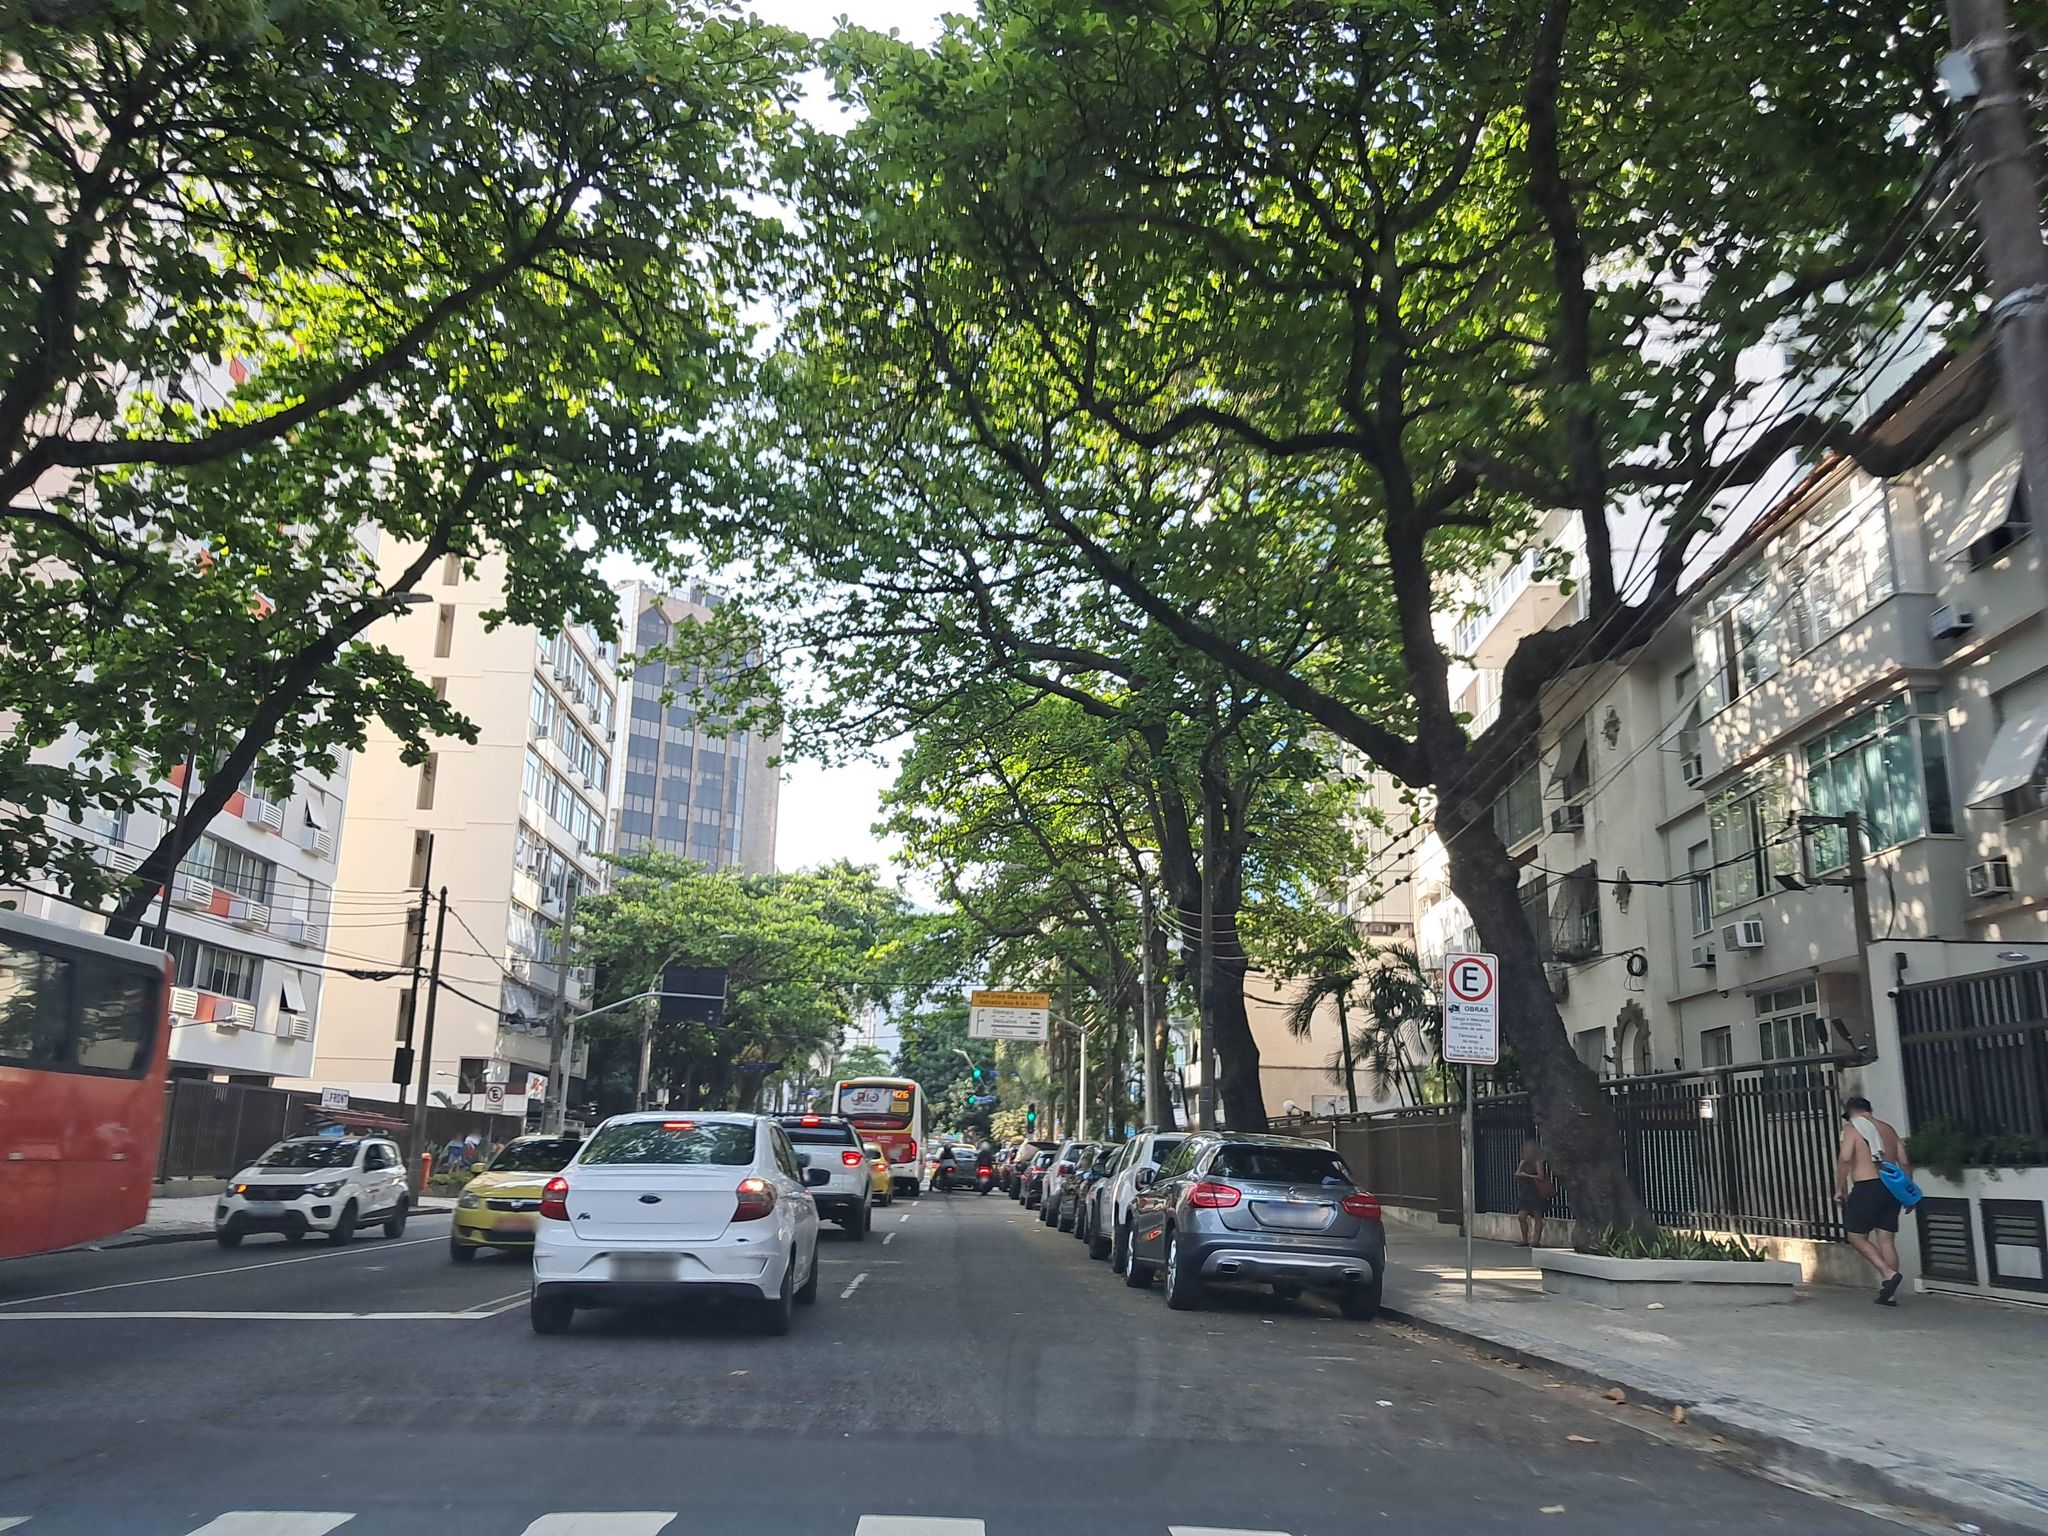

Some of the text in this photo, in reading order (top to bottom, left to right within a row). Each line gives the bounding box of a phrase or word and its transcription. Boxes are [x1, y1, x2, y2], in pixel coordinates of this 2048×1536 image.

[1462, 966, 1479, 992] E
[1464, 1005, 1489, 1013] OBRAS
[492, 1089, 499, 1099] E
